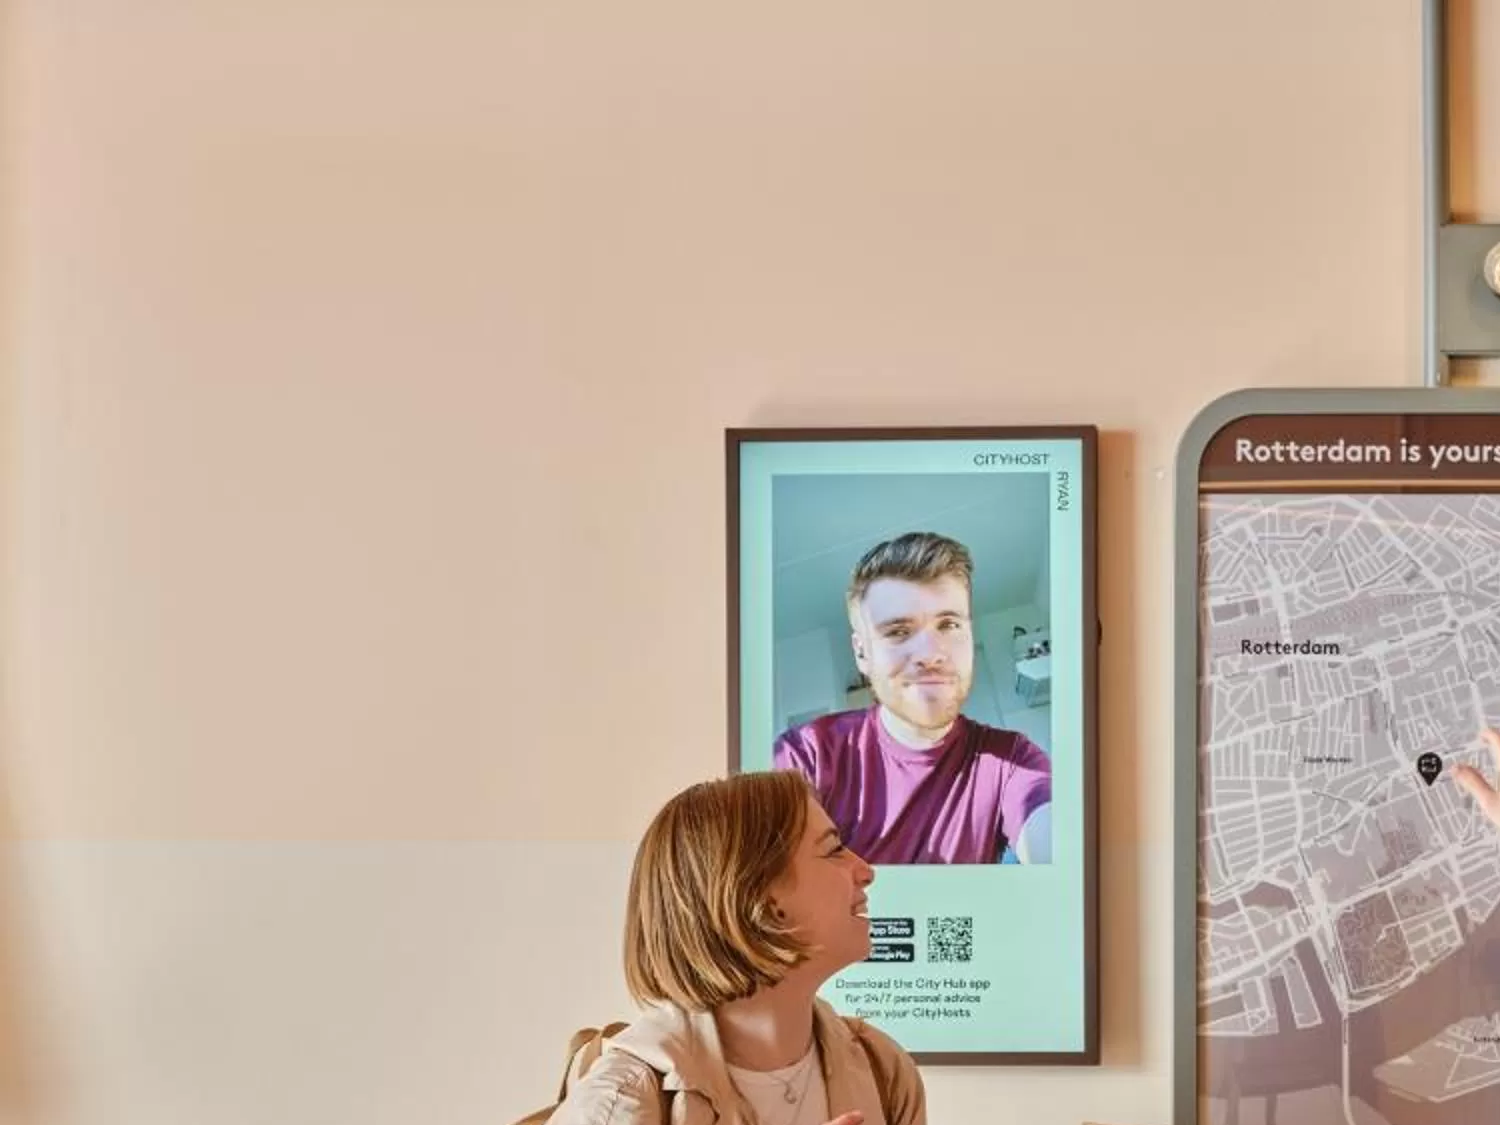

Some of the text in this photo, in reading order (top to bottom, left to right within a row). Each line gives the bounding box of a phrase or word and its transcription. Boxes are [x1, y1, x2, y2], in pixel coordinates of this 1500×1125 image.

[1235, 438, 1391, 462] Rotterdam
[1400, 438, 1421, 462] is
[973, 453, 1050, 466] CITYHOST
[1056, 471, 1070, 511] RYAN
[1241, 639, 1340, 655] Rotterdam
[888, 926, 910, 935] Store
[893, 979, 913, 989] the
[915, 979, 941, 991] City
[943, 979, 967, 989] Hub
[969, 980, 991, 991] app
[863, 993, 892, 1004] 24/7
[893, 994, 941, 1005] personal
[943, 993, 981, 1003] advice
[883, 1010, 909, 1020] your
[912, 1008, 971, 1020] CityHosts
